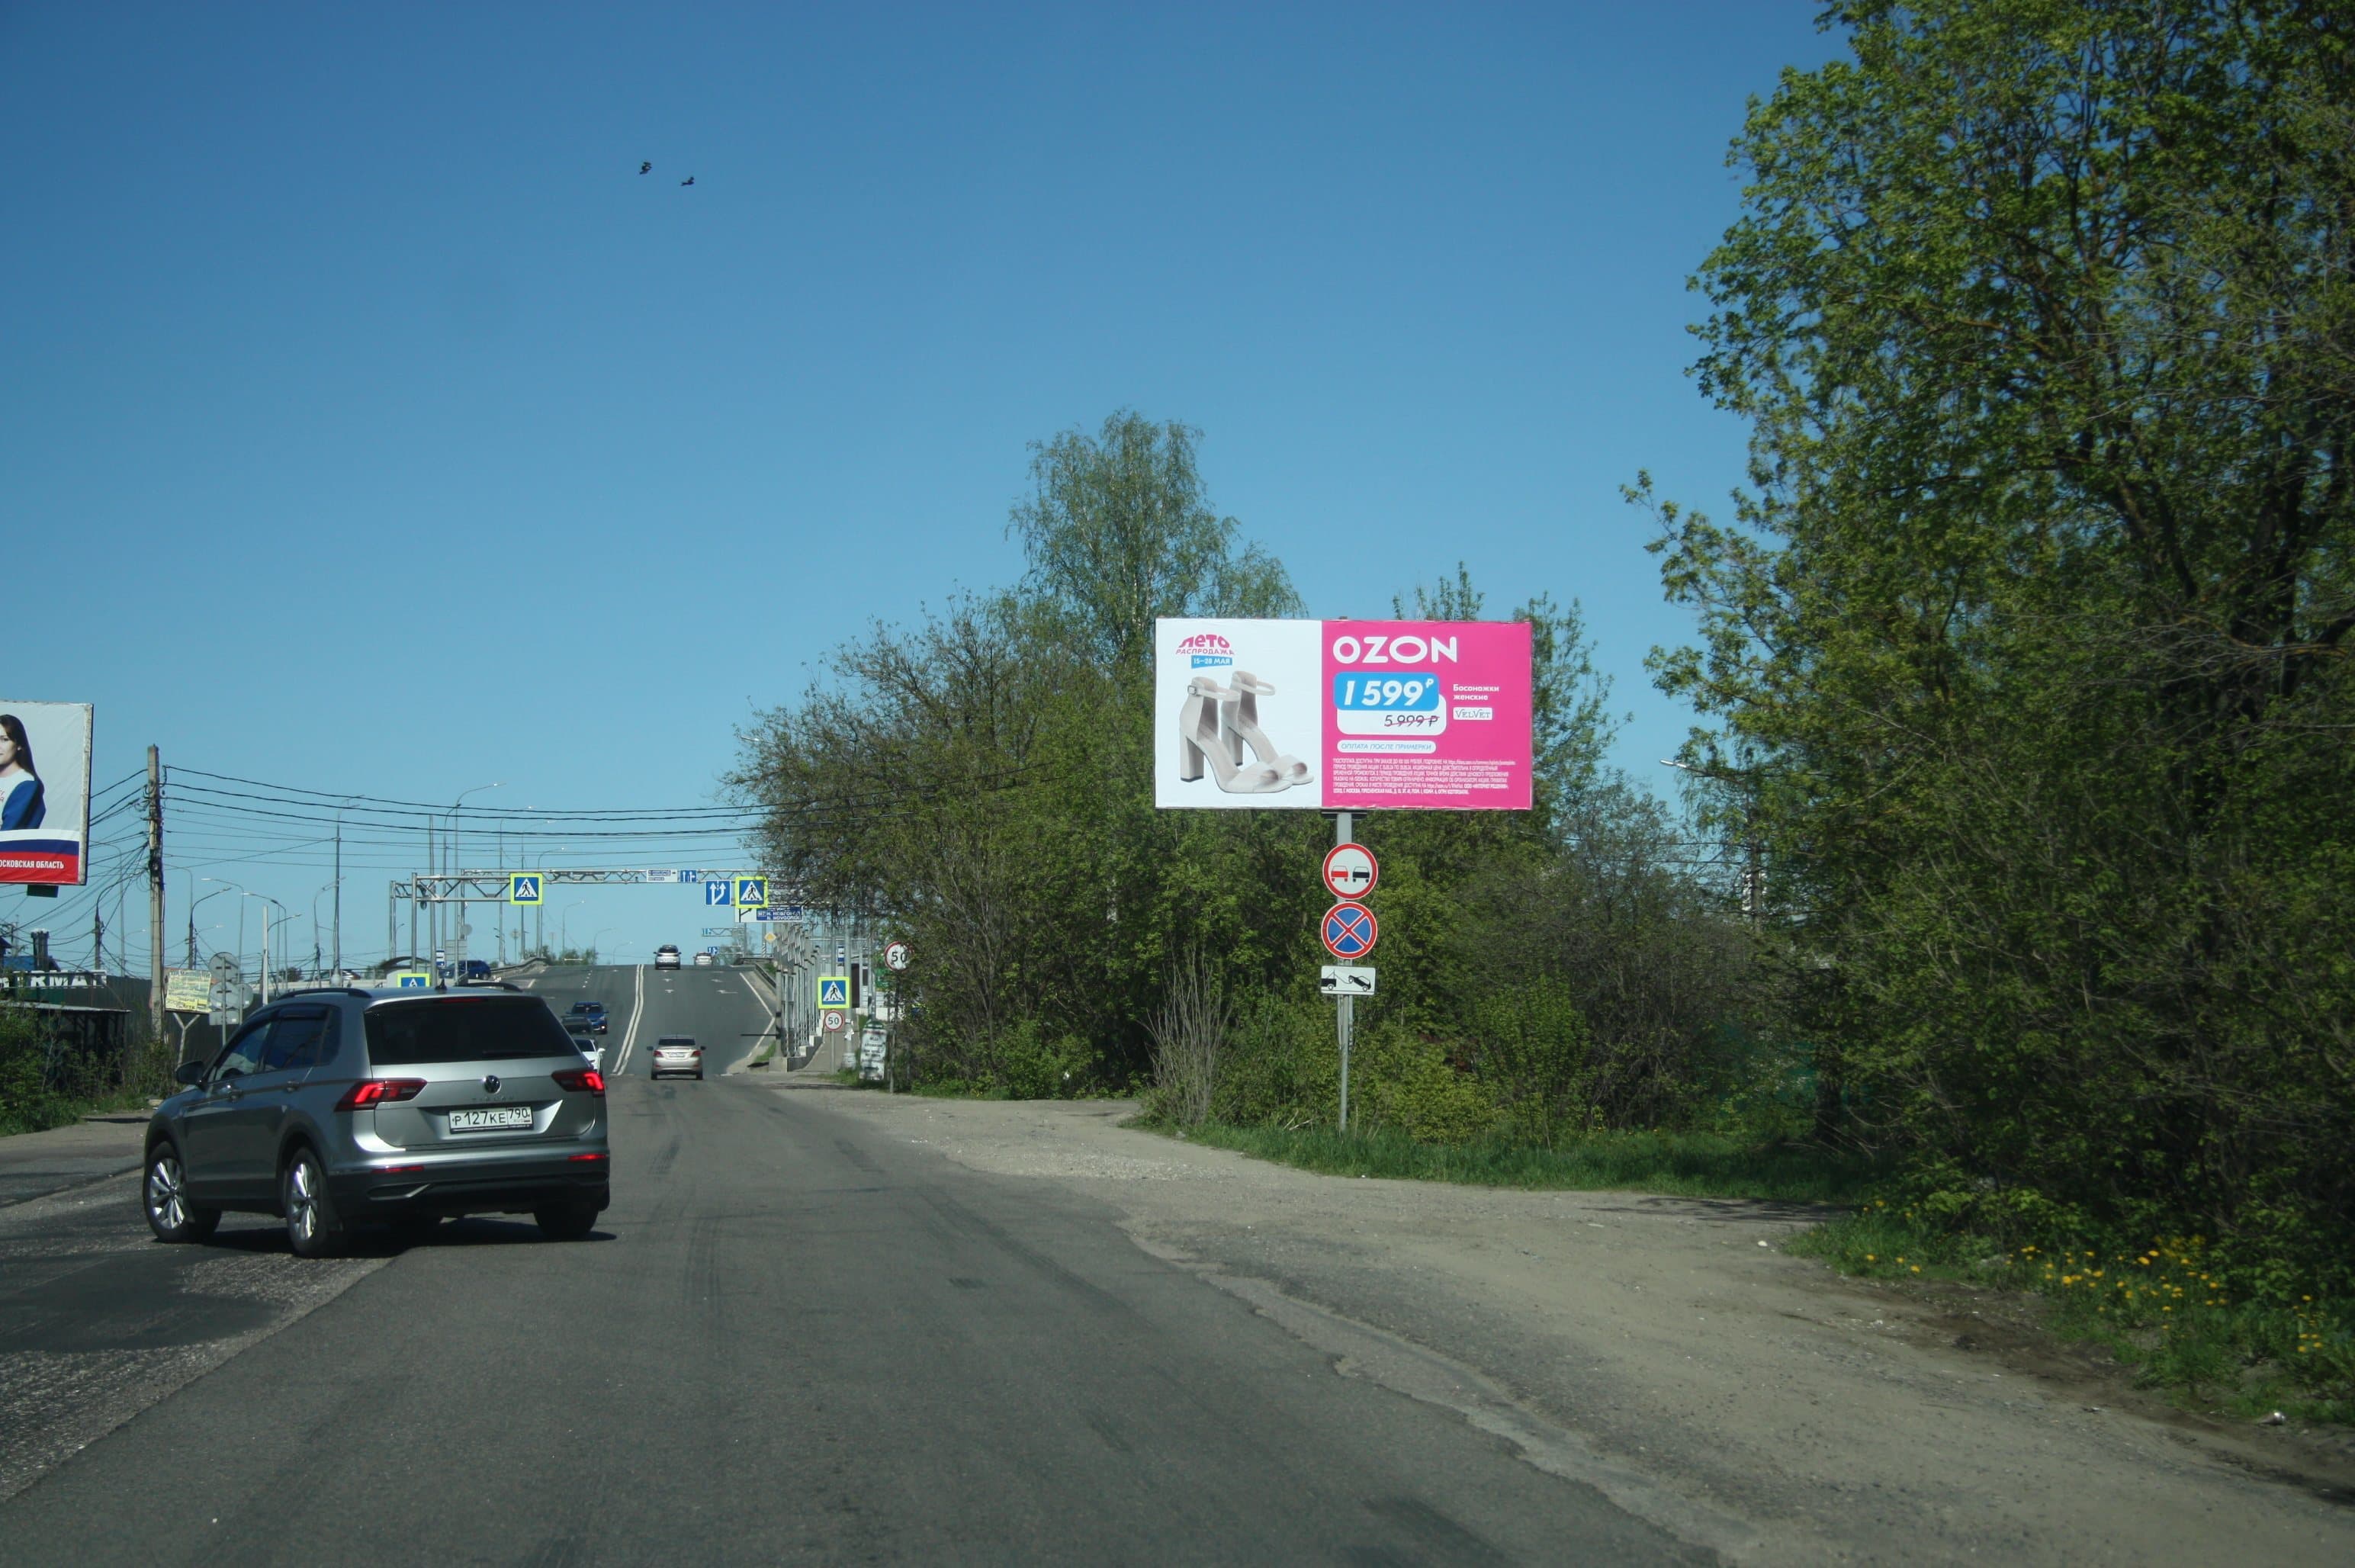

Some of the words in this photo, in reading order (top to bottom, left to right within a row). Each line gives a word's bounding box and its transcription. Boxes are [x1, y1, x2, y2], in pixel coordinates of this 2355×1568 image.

[1332, 635, 1457, 664] OZON
[1453, 683, 1500, 692] Босоножки
[0, 860, 35, 868] ОСКОВСКАЯ
[36, 860, 65, 869] ОБЛАСТЬ
[891, 951, 908, 962] 50
[827, 1017, 840, 1025] 50
[507, 1108, 528, 1119] 790
